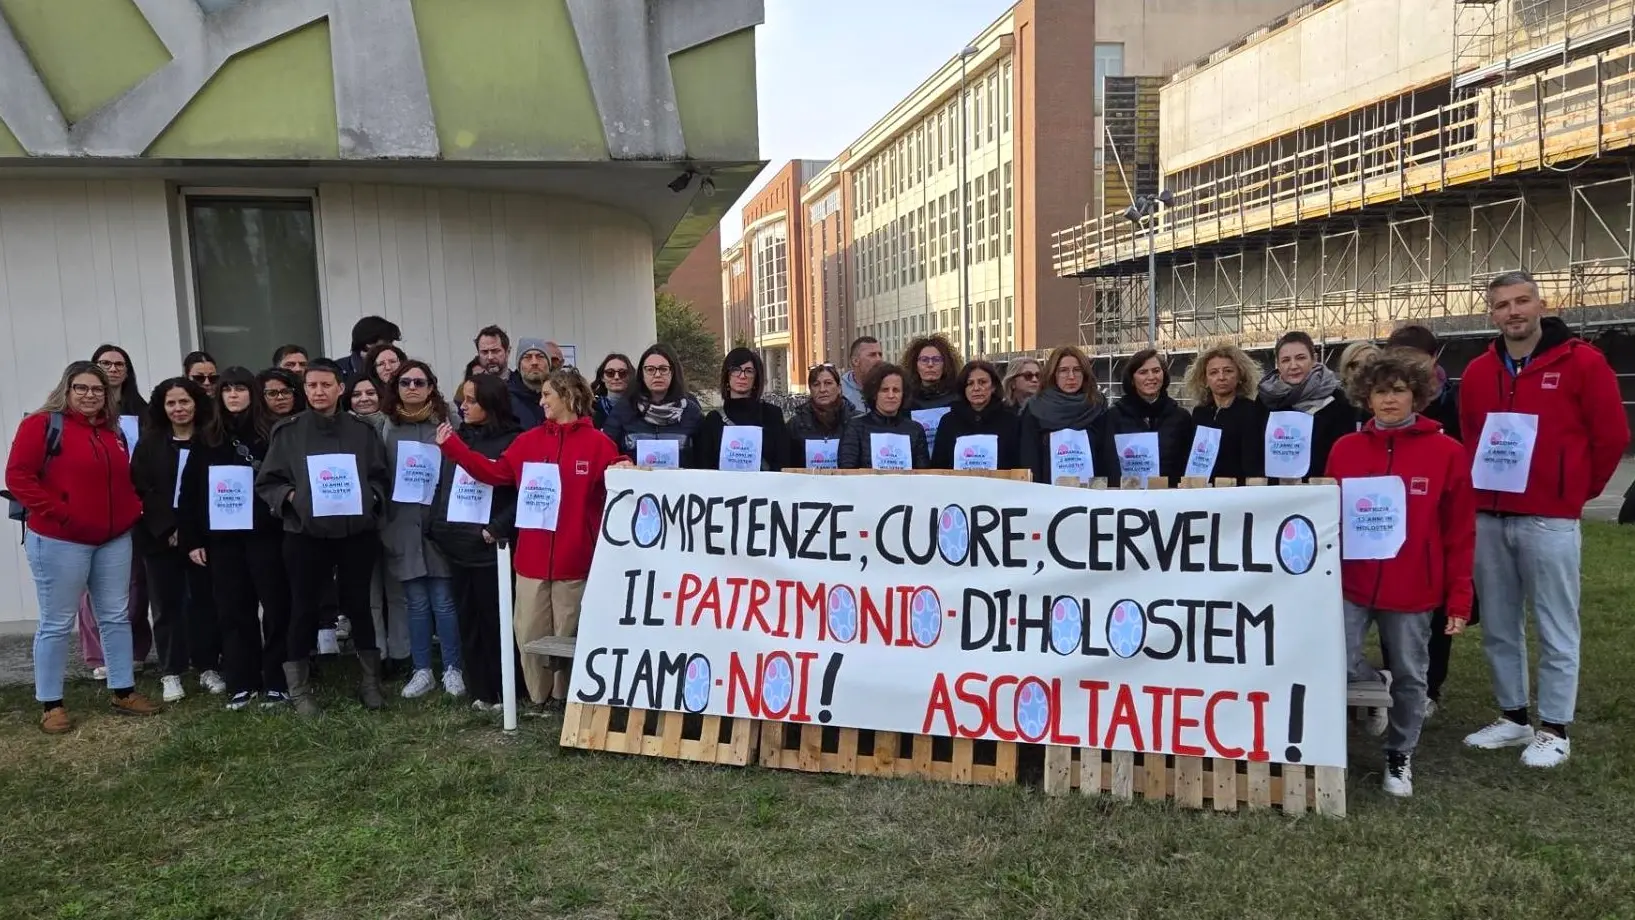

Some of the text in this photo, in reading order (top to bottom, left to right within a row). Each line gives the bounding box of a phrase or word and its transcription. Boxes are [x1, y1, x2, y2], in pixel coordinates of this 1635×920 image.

[619, 569, 1275, 666] IL PATRIMONIO DI HOLOSTEM
[576, 647, 1306, 763] SIAMO NOI! ASCOLTATECI!
